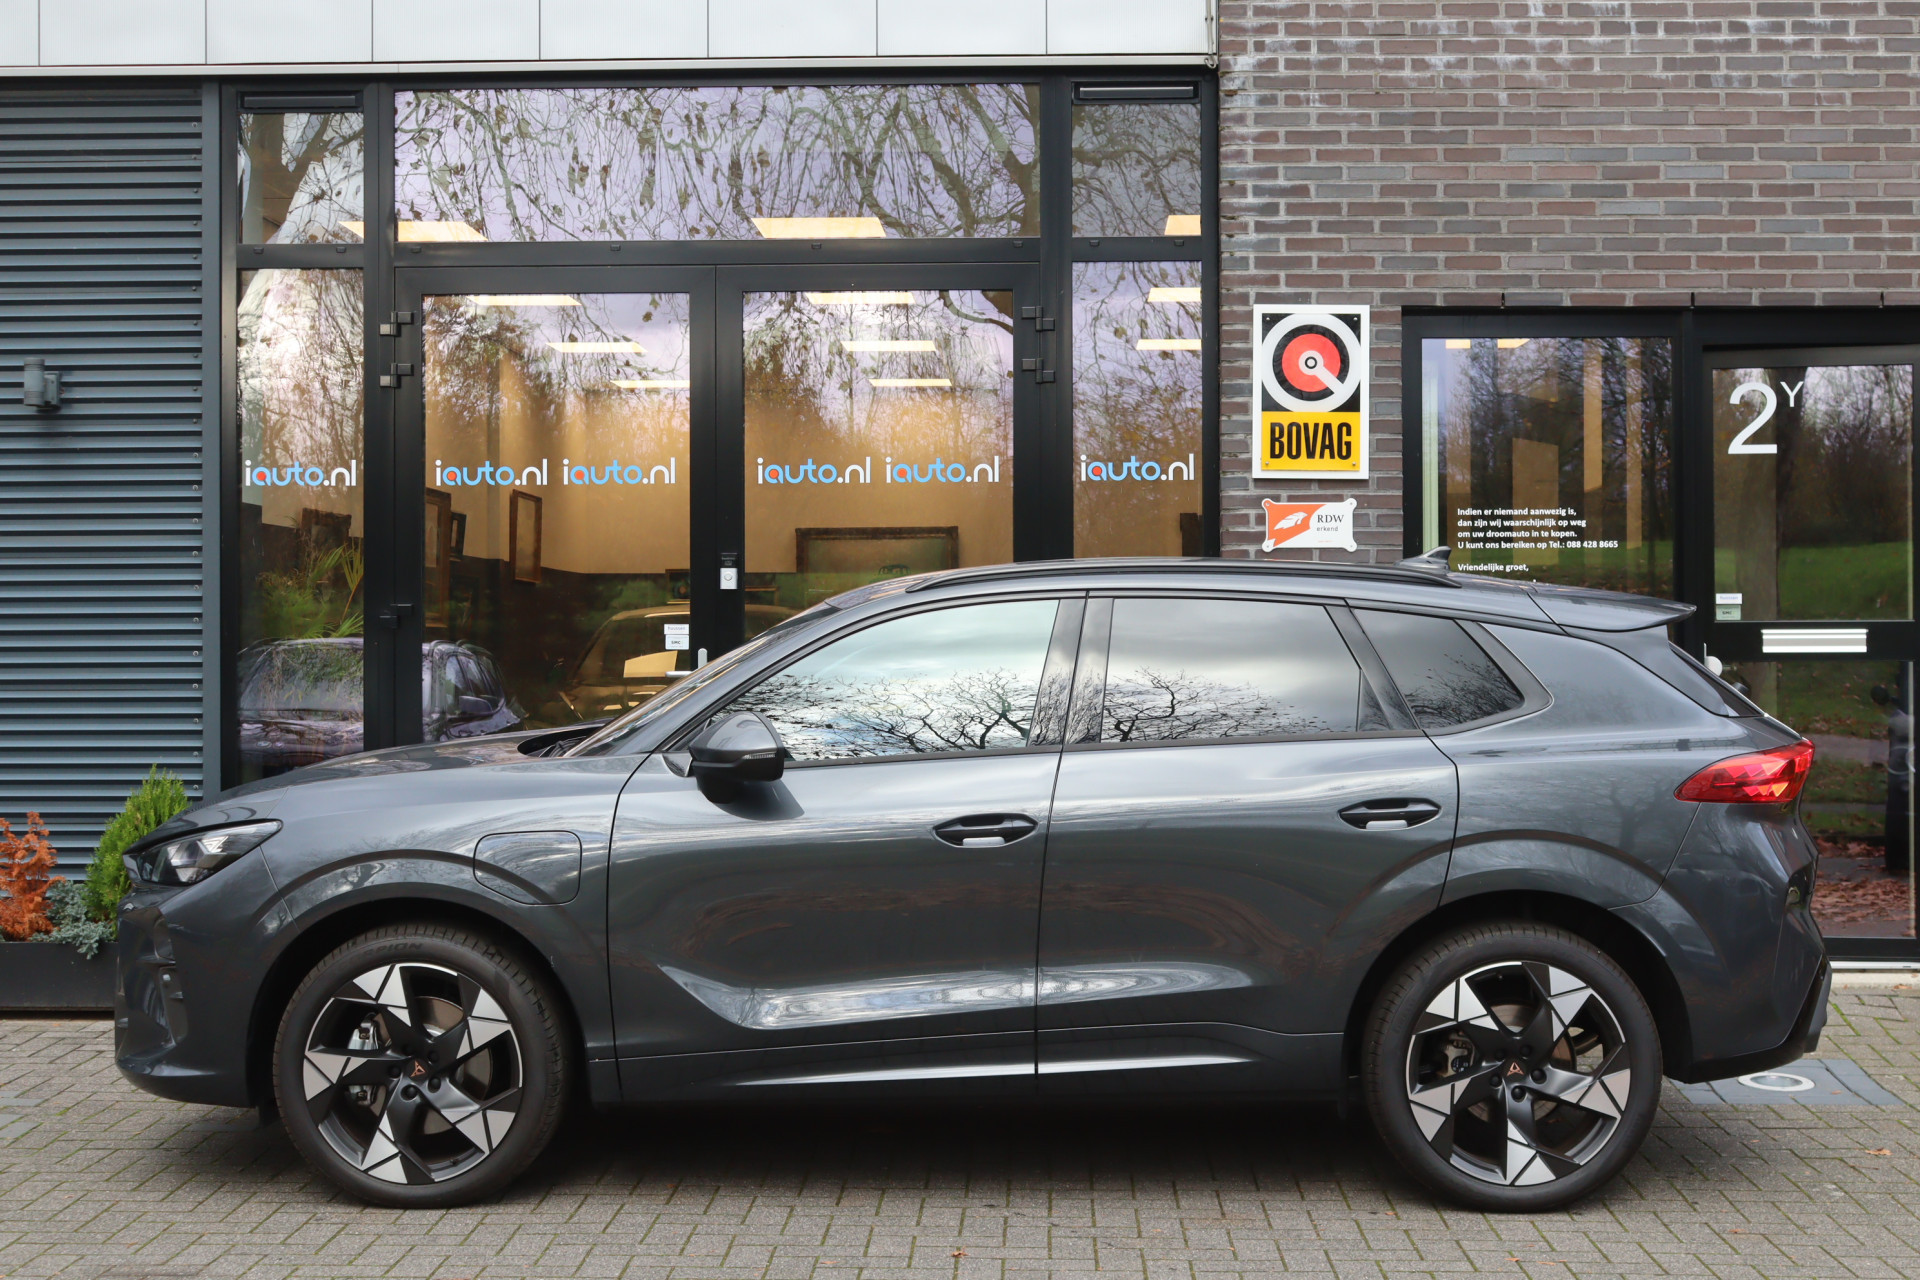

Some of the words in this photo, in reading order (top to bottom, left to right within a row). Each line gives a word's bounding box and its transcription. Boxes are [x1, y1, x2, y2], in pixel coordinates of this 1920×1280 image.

[1270, 422, 1352, 460] BOVAG
[245, 459, 357, 486] iauto.nl
[434, 458, 548, 486] iauto.nl
[562, 457, 676, 485] iauto.nl
[757, 456, 871, 484] iauto.nl
[885, 455, 1000, 483] iauto.nl
[1080, 453, 1195, 482] iauto.nl
[1457, 508, 1482, 516] Indien
[1494, 507, 1529, 516] niemand
[1530, 507, 1567, 517] aanwezig
[1567, 507, 1577, 516] is,
[1317, 514, 1344, 523] RDW
[1457, 518, 1473, 527] dan
[1474, 518, 1488, 528] zijn
[1489, 518, 1502, 528] wij
[1503, 518, 1557, 528] waarschijnlijk
[1557, 519, 1568, 528] op
[1569, 519, 1587, 528] weg
[1486, 529, 1530, 538] droomauto
[1531, 529, 1539, 537] in
[1550, 529, 1578, 539] kopen.
[1457, 541, 1464, 549] U
[1465, 540, 1484, 549] kunt
[1501, 540, 1535, 549] bereiken
[1536, 541, 1547, 550] op
[1549, 540, 1565, 549] Tel.:
[1566, 540, 1582, 548] 088
[1583, 540, 1598, 548] 428
[1599, 540, 1619, 548] 8665
[1457, 563, 1504, 572] Vriendelijke
[1505, 563, 1529, 572] groet,
